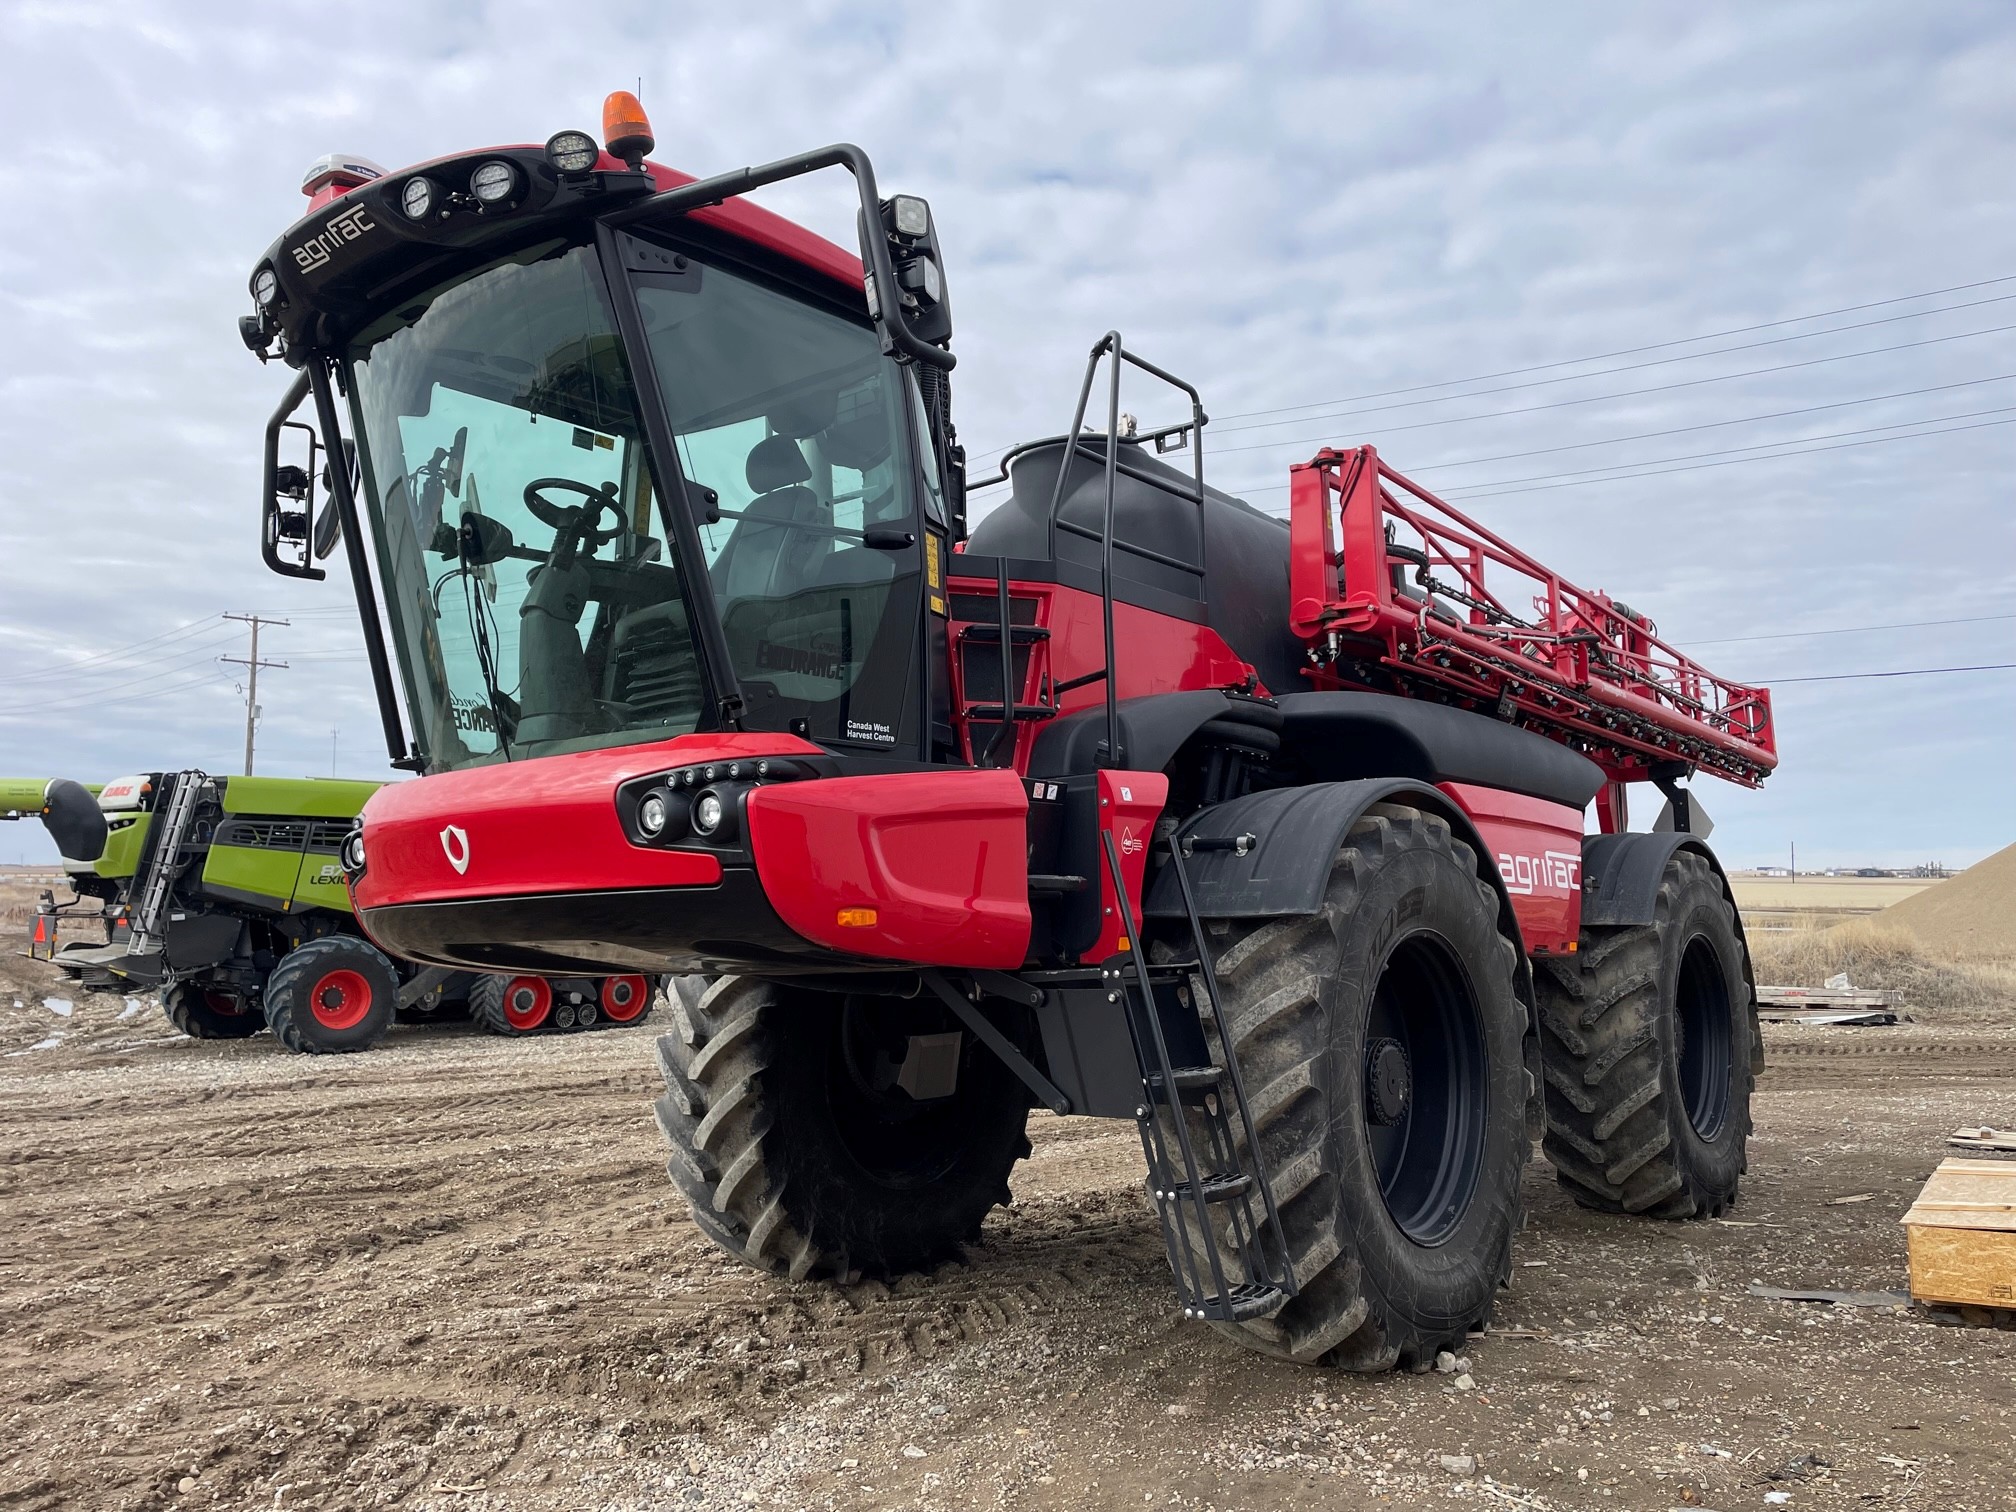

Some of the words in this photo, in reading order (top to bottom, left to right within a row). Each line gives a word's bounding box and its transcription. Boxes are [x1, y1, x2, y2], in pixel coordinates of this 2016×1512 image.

[292, 202, 375, 275] agrifac
[847, 719, 873, 731] Canada
[873, 722, 890, 733] West
[847, 729, 873, 740] Harvest
[873, 732, 895, 743] Centre
[104, 786, 135, 797] CLAAS
[320, 865, 342, 876] 87
[1498, 850, 1582, 895] agrifac
